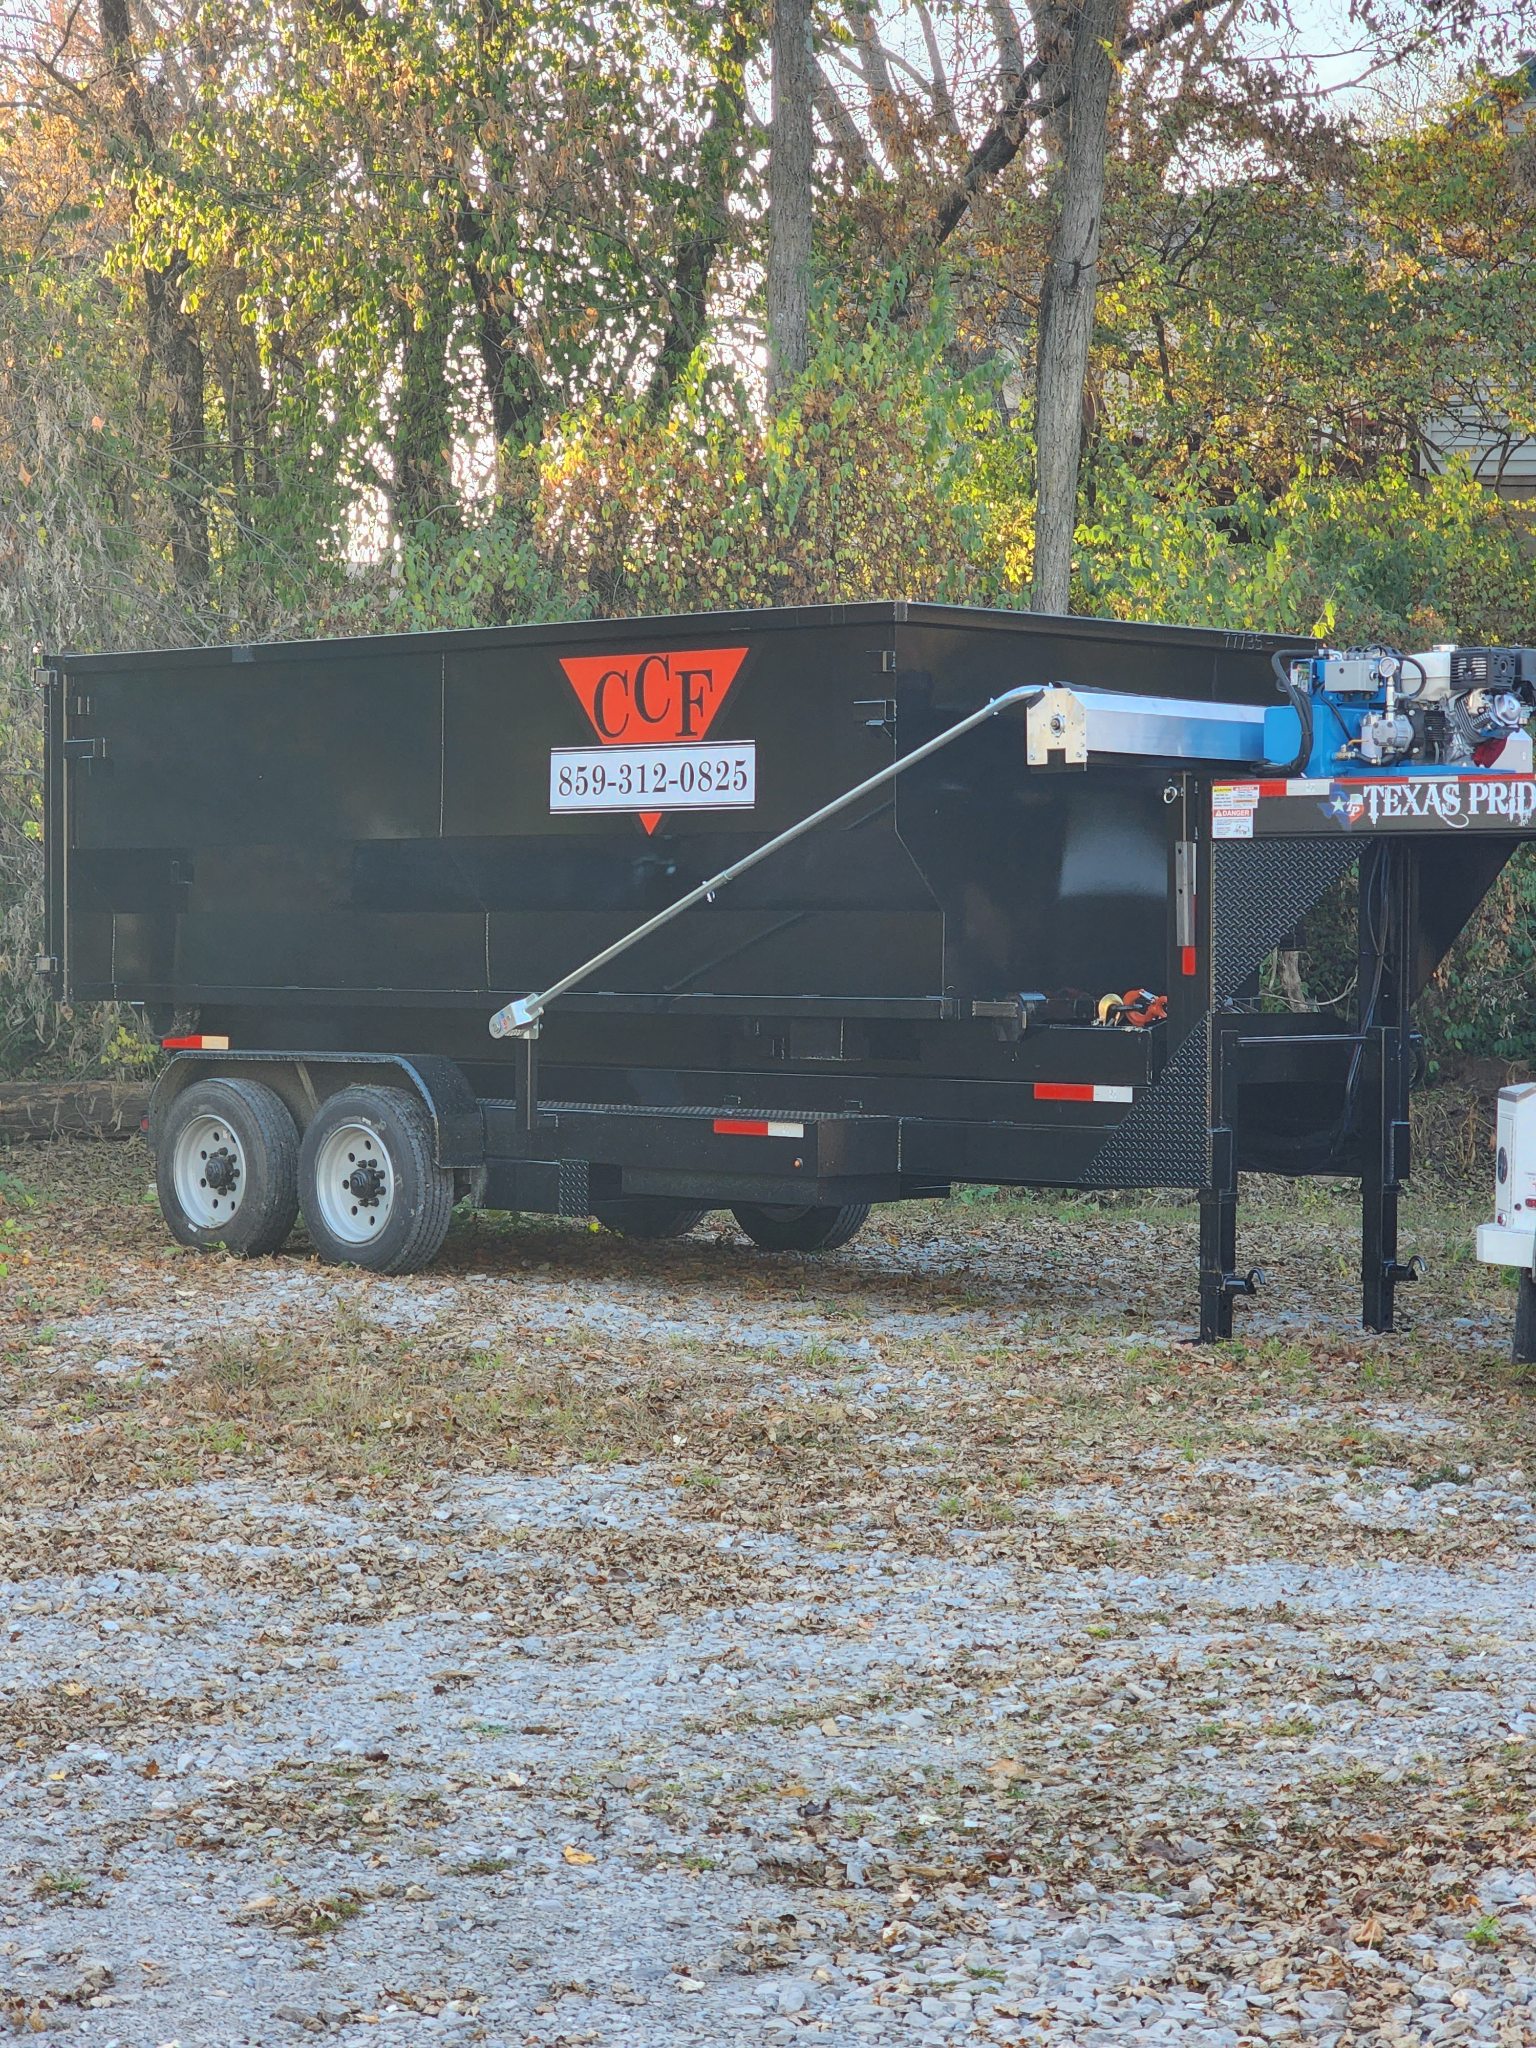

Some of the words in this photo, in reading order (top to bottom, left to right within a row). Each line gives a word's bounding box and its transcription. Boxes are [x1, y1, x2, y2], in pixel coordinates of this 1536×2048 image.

[593, 654, 713, 738] CCF
[558, 759, 748, 796] 859-312-0825
[1222, 809, 1250, 817] DANGER
[1363, 783, 1469, 828] TEXAS
